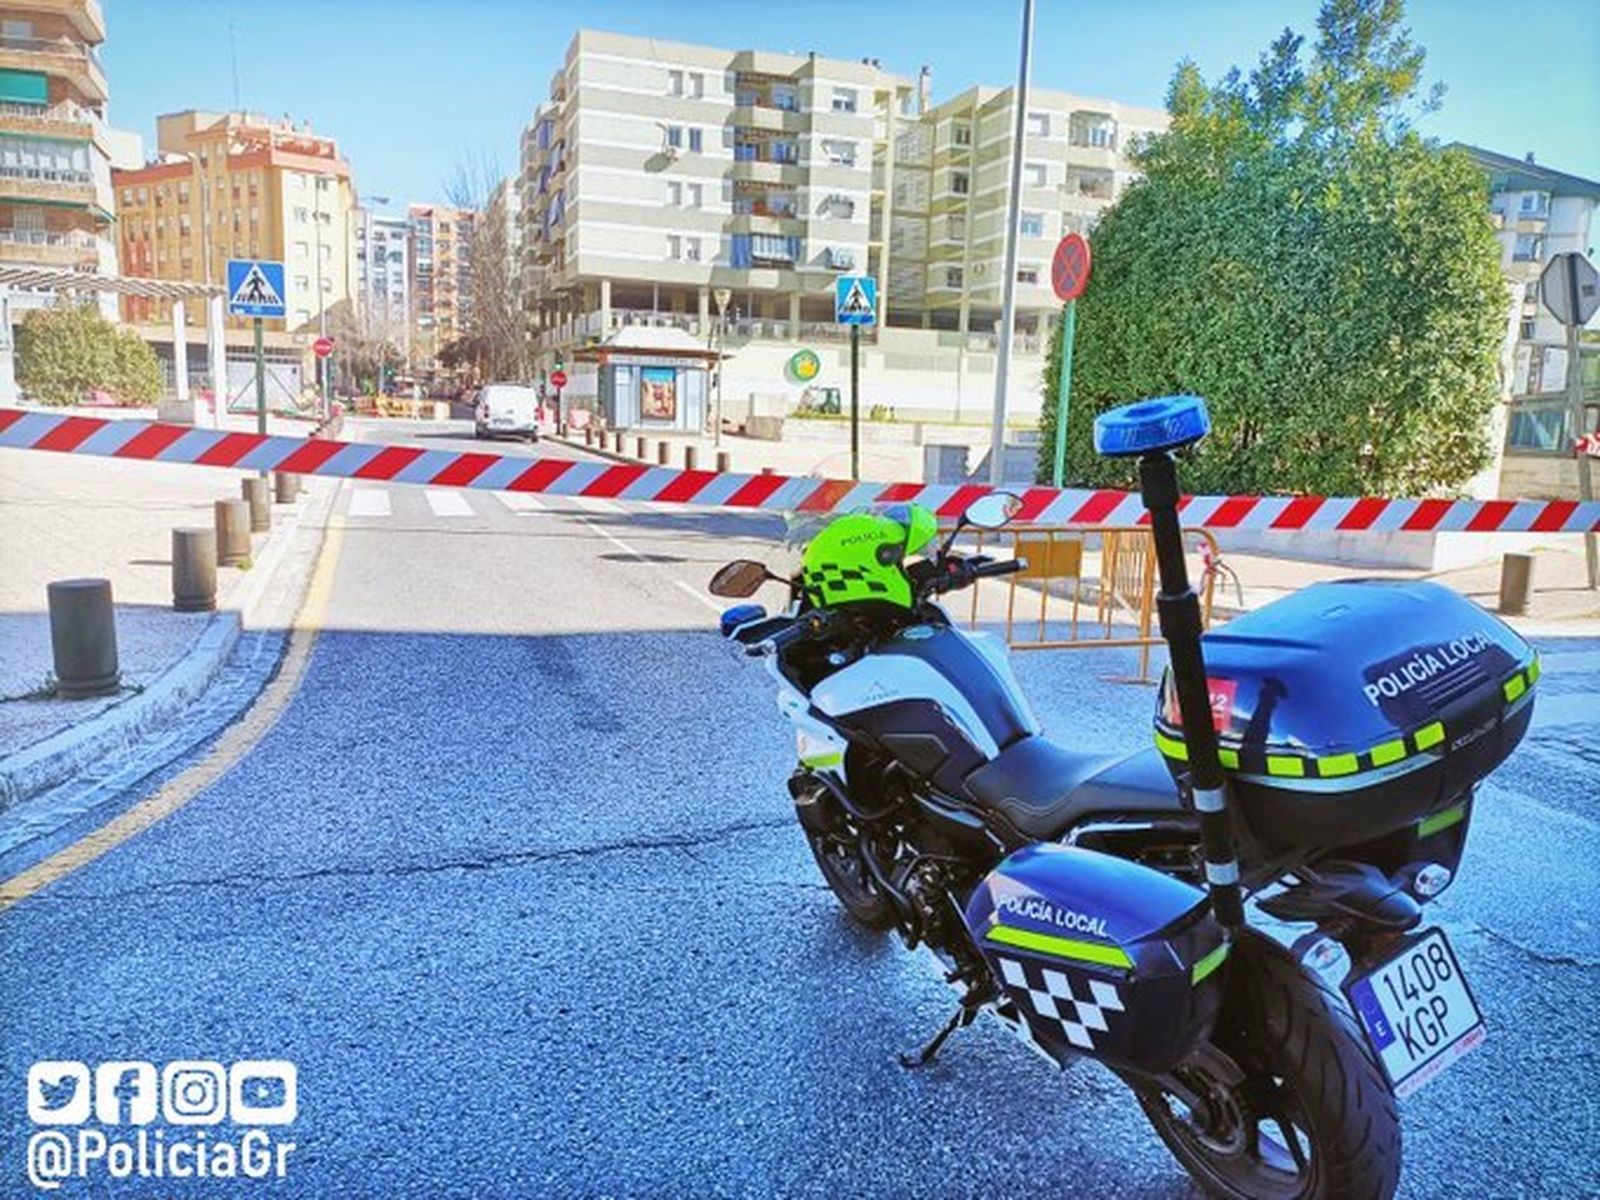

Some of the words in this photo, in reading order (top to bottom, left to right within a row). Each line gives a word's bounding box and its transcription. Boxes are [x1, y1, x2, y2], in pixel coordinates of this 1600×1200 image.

[1362, 652, 1446, 707] POLICÍA
[1437, 627, 1495, 666] LOCAL
[1055, 908, 1108, 937] LOCAL
[1382, 942, 1452, 1013] 1408
[1374, 1019, 1387, 1037] E
[1396, 995, 1449, 1061] KGP
